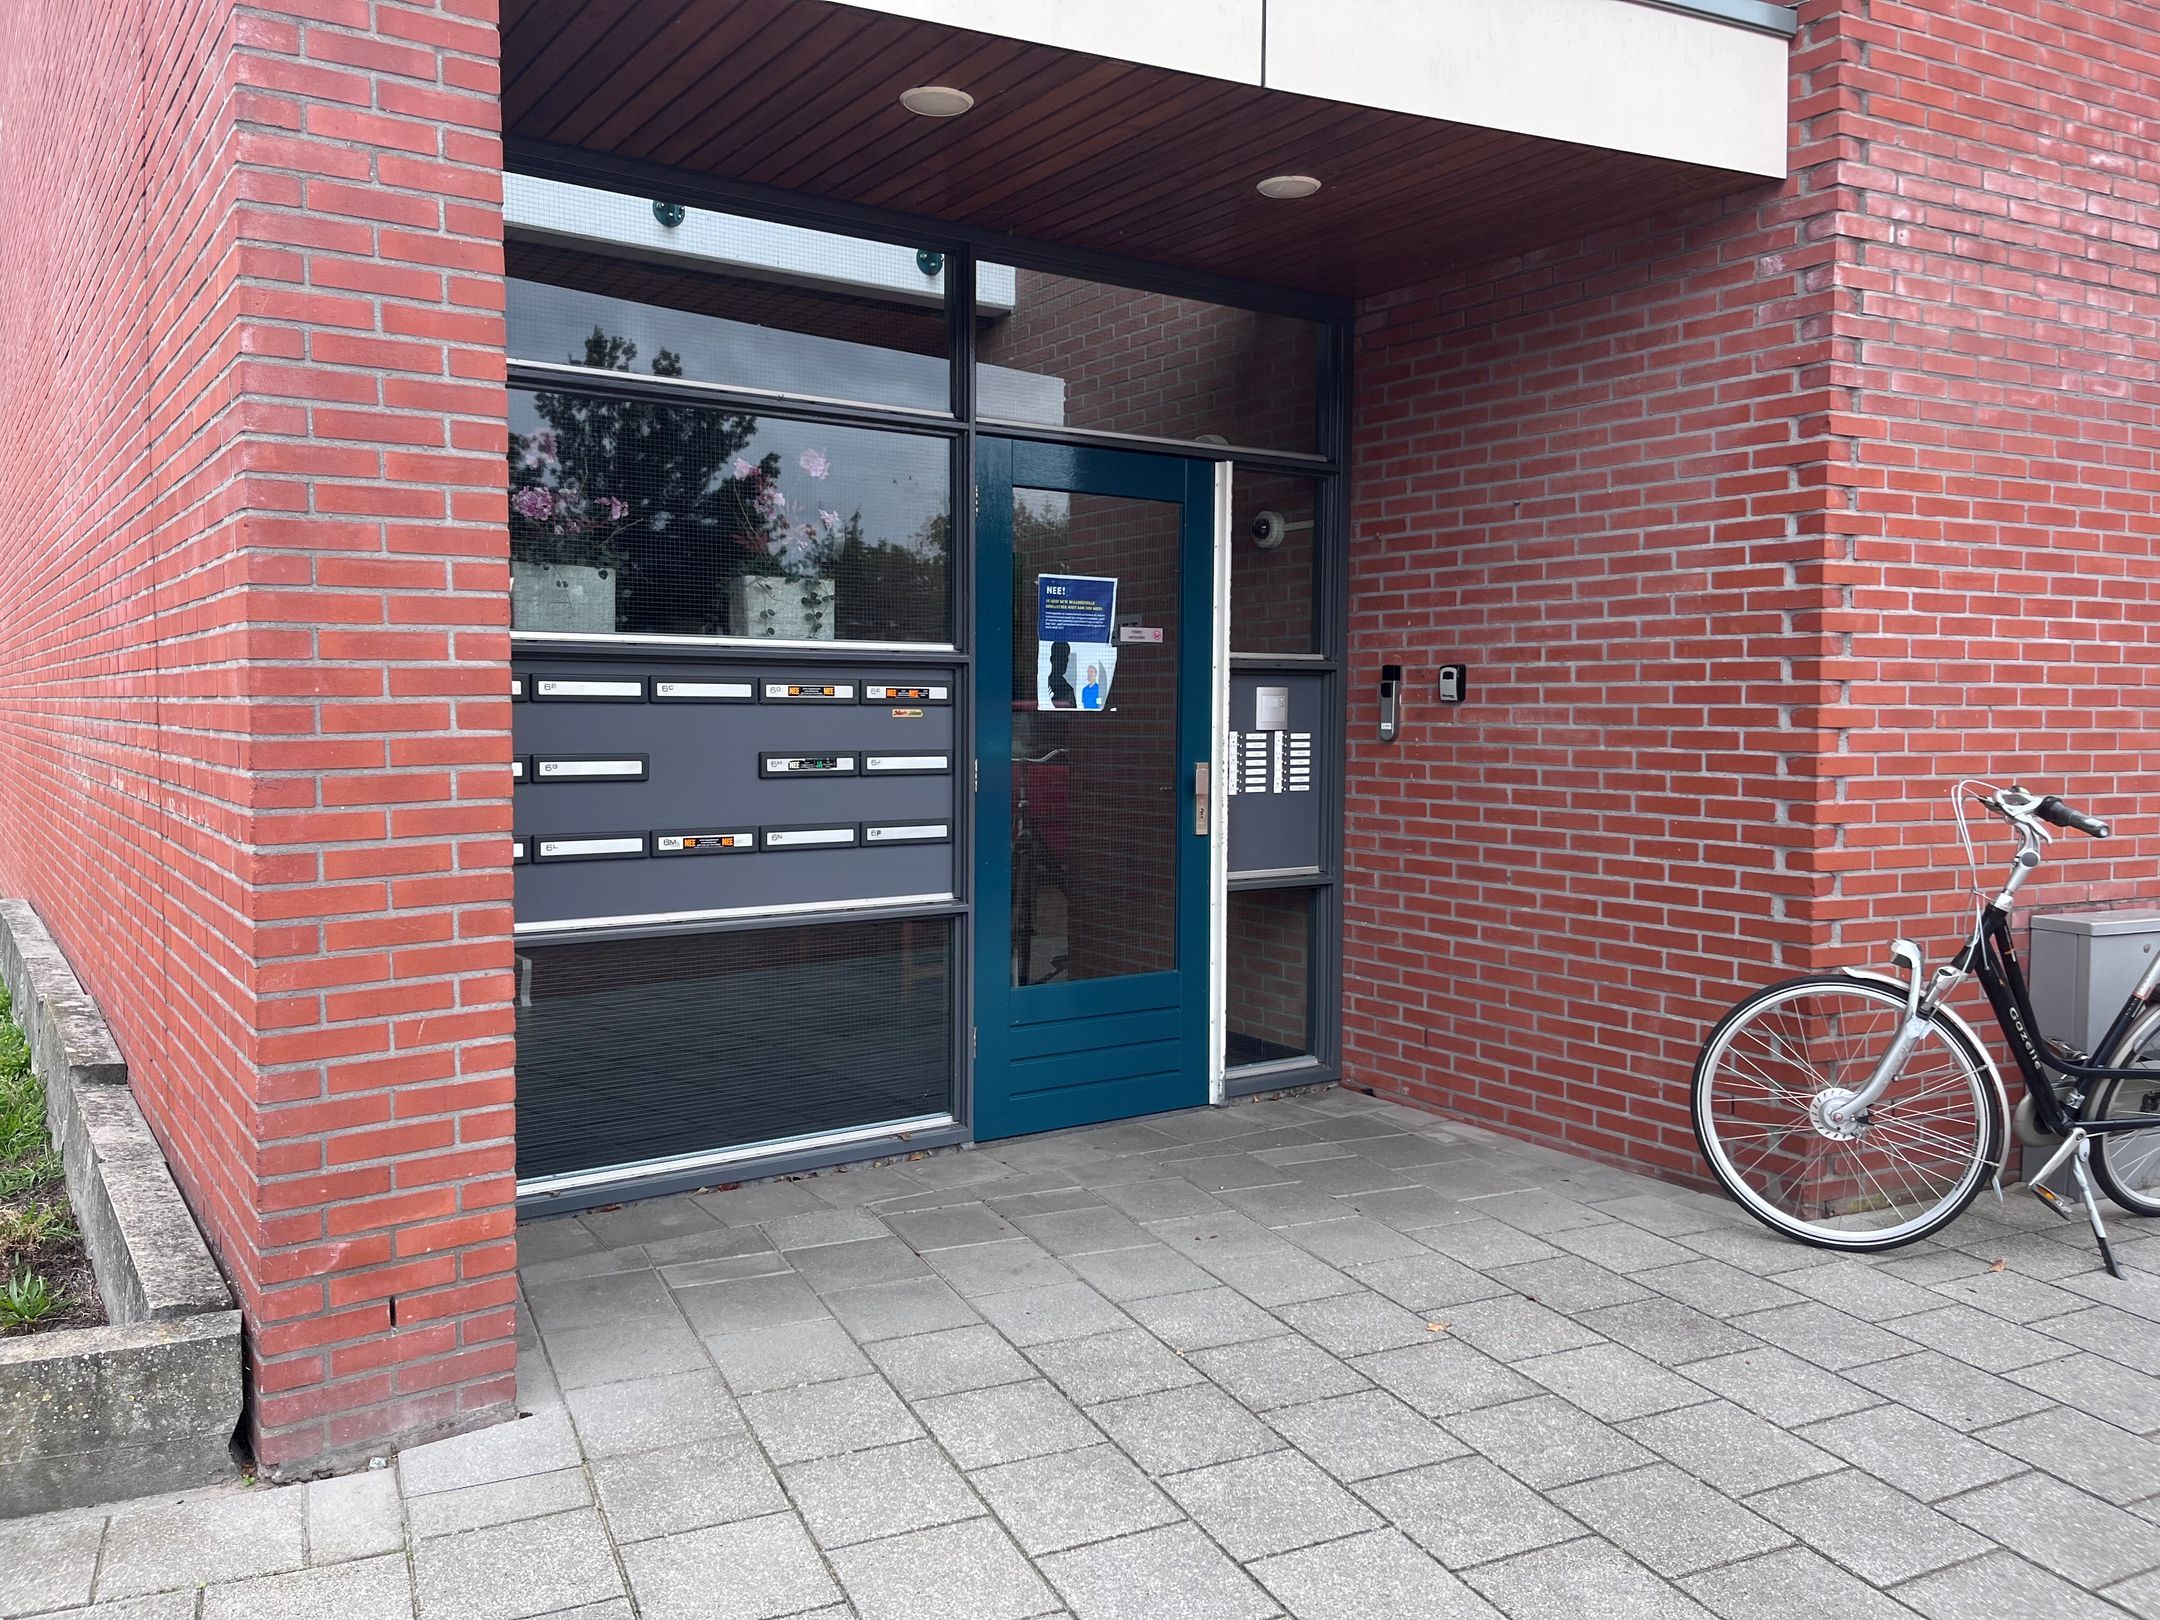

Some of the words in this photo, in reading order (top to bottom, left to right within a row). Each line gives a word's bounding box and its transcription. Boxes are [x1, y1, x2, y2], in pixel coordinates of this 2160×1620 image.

[1046, 586, 1066, 595] NEE!
[661, 685, 674, 693] 6C
[789, 687, 800, 695] NEE
[823, 687, 834, 695] NEE
[887, 689, 897, 697] NEE
[909, 689, 919, 697] NEE
[789, 761, 800, 769] NEE
[815, 761, 823, 769] JA
[684, 839, 696, 847] NEE
[722, 837, 733, 846] NEE
[2009, 1006, 2041, 1070] Gazelle
